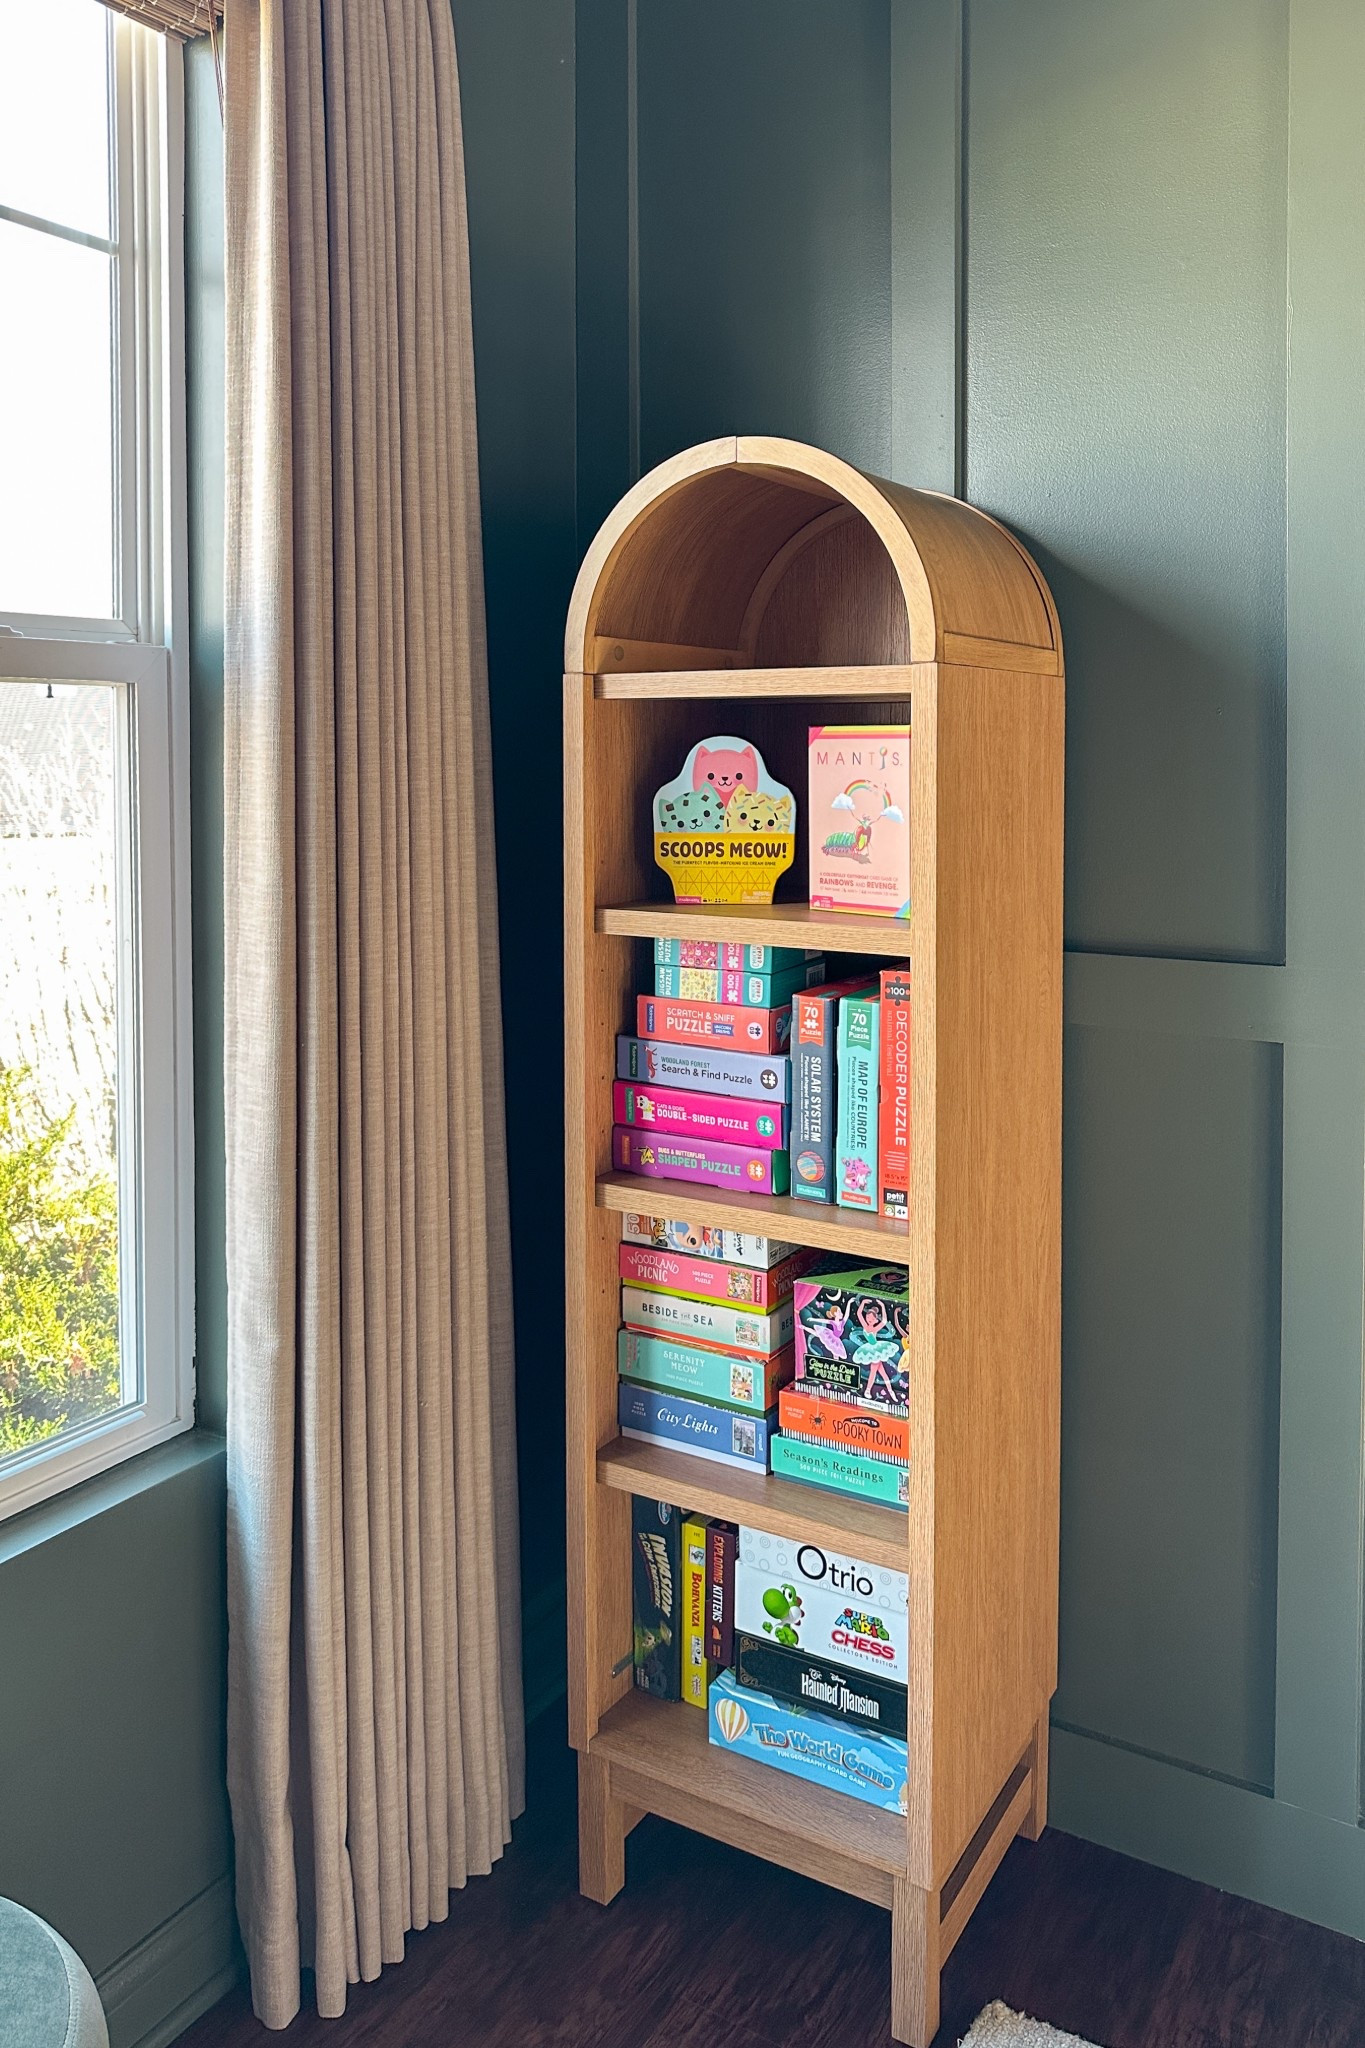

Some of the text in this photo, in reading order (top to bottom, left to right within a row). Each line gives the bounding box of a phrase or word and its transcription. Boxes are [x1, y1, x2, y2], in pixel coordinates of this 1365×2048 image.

[816, 746, 901, 770] MANTIS
[660, 841, 787, 859] SCOOPS MEOW!
[819, 877, 854, 887] RAINBOWS
[866, 881, 899, 890] REVENGE.
[889, 986, 905, 996] 100
[666, 1008, 735, 1022] SCRATCH & SNIFF
[803, 1006, 819, 1018] 70
[851, 1013, 867, 1025] 70
[666, 1017, 712, 1034] PUZZLE
[749, 1026, 755, 1035] 60
[801, 1028, 821, 1036] Puzzle
[848, 1031, 870, 1040] Puzzle
[850, 1025, 868, 1033] Piece
[660, 1056, 710, 1069] WOODLAND FOREST
[886, 1042, 894, 1077] festival
[661, 1064, 753, 1085] Search & Find Puzzle
[895, 1010, 908, 1146] DECODER PUZZLE
[810, 1056, 822, 1143] SOLAR SYSTEM
[856, 1061, 869, 1149] MAP OF EUROPE
[657, 1109, 749, 1130] DOUBLE-SIDED PUZZLE
[658, 1147, 670, 1155] BUGS
[675, 1149, 706, 1160] BUTTERFLIES
[657, 1154, 741, 1176] SHAPED PUZZLE
[886, 1192, 905, 1202] petit
[627, 1251, 680, 1275] WOODLAND
[637, 1265, 668, 1282] PICNIC
[694, 1277, 711, 1285] PUZZLE
[642, 1302, 678, 1319] BESIDE
[693, 1314, 713, 1327] SEA
[781, 1316, 793, 1331] BES
[663, 1350, 705, 1367] SERENITY
[671, 1361, 698, 1375] MEOW
[808, 1358, 823, 1370] Glow
[839, 1364, 856, 1376] Dark
[688, 1379, 704, 1387] PUZZLE
[813, 1368, 852, 1384] PUZZLE
[631, 1409, 646, 1417] PUZZLE
[657, 1407, 719, 1435] City Lights
[850, 1418, 870, 1426] WELCOME
[832, 1419, 902, 1450] SPOOKY TOWN
[783, 1448, 884, 1483] Season's Readings
[799, 1464, 865, 1487] 500 PIECE FOIL PUZZLE
[642, 1541, 655, 1563] COW
[648, 1533, 673, 1618] INVASION
[712, 1534, 724, 1623] EXPLODING KITTENS
[797, 1545, 873, 1596] Otrio
[691, 1571, 703, 1627] BOHNANZA
[835, 1614, 890, 1641] MARIO
[843, 1607, 883, 1628] SUPER
[831, 1630, 896, 1660] CHESS
[828, 1643, 898, 1669] COLLECTOR'S EDITION
[801, 1673, 880, 1720] Haunted Mansion
[752, 1723, 895, 1791] The World Game
[777, 1750, 867, 1788] FUN GEOGRAPHY BOARD GAME
